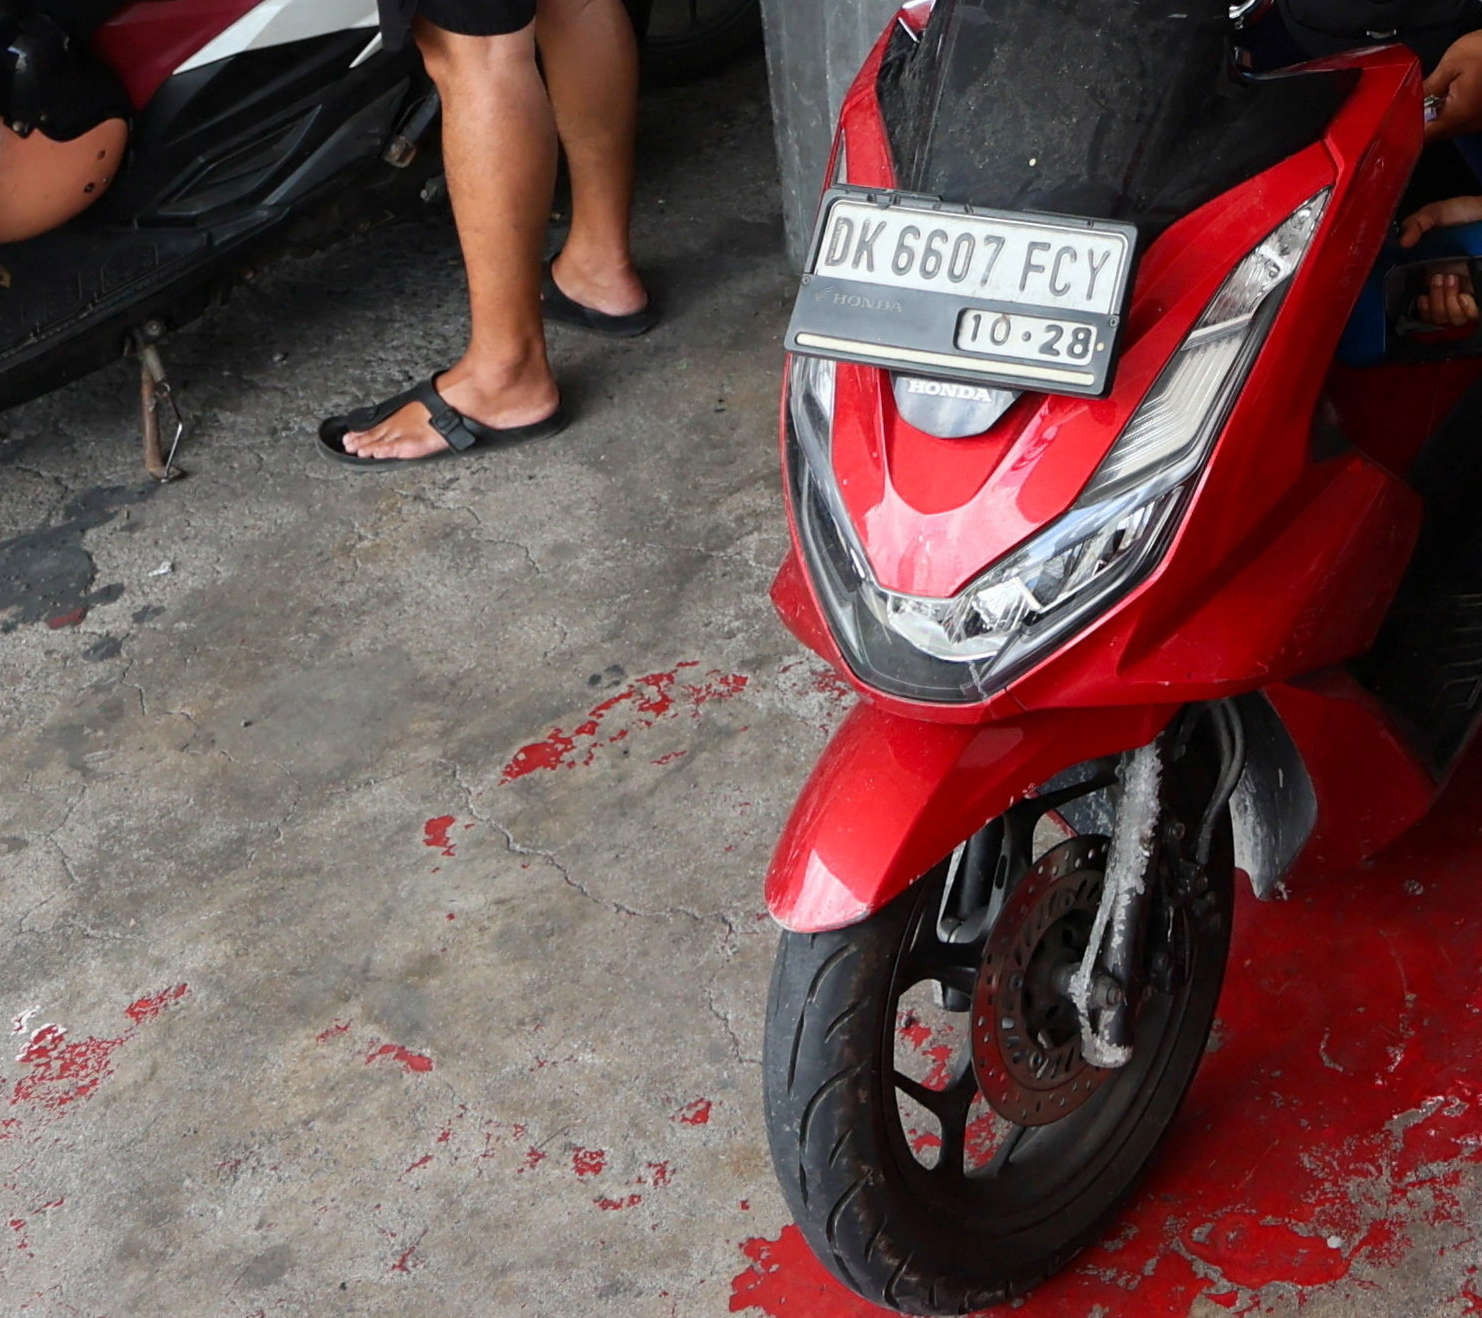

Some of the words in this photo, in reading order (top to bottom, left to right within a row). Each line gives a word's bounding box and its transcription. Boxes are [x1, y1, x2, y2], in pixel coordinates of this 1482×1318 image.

[825, 216, 882, 273] DK
[890, 224, 1007, 288] 6607
[1021, 241, 1113, 303] FCY
[832, 291, 905, 315] HONDA
[907, 380, 993, 405] HONDA
